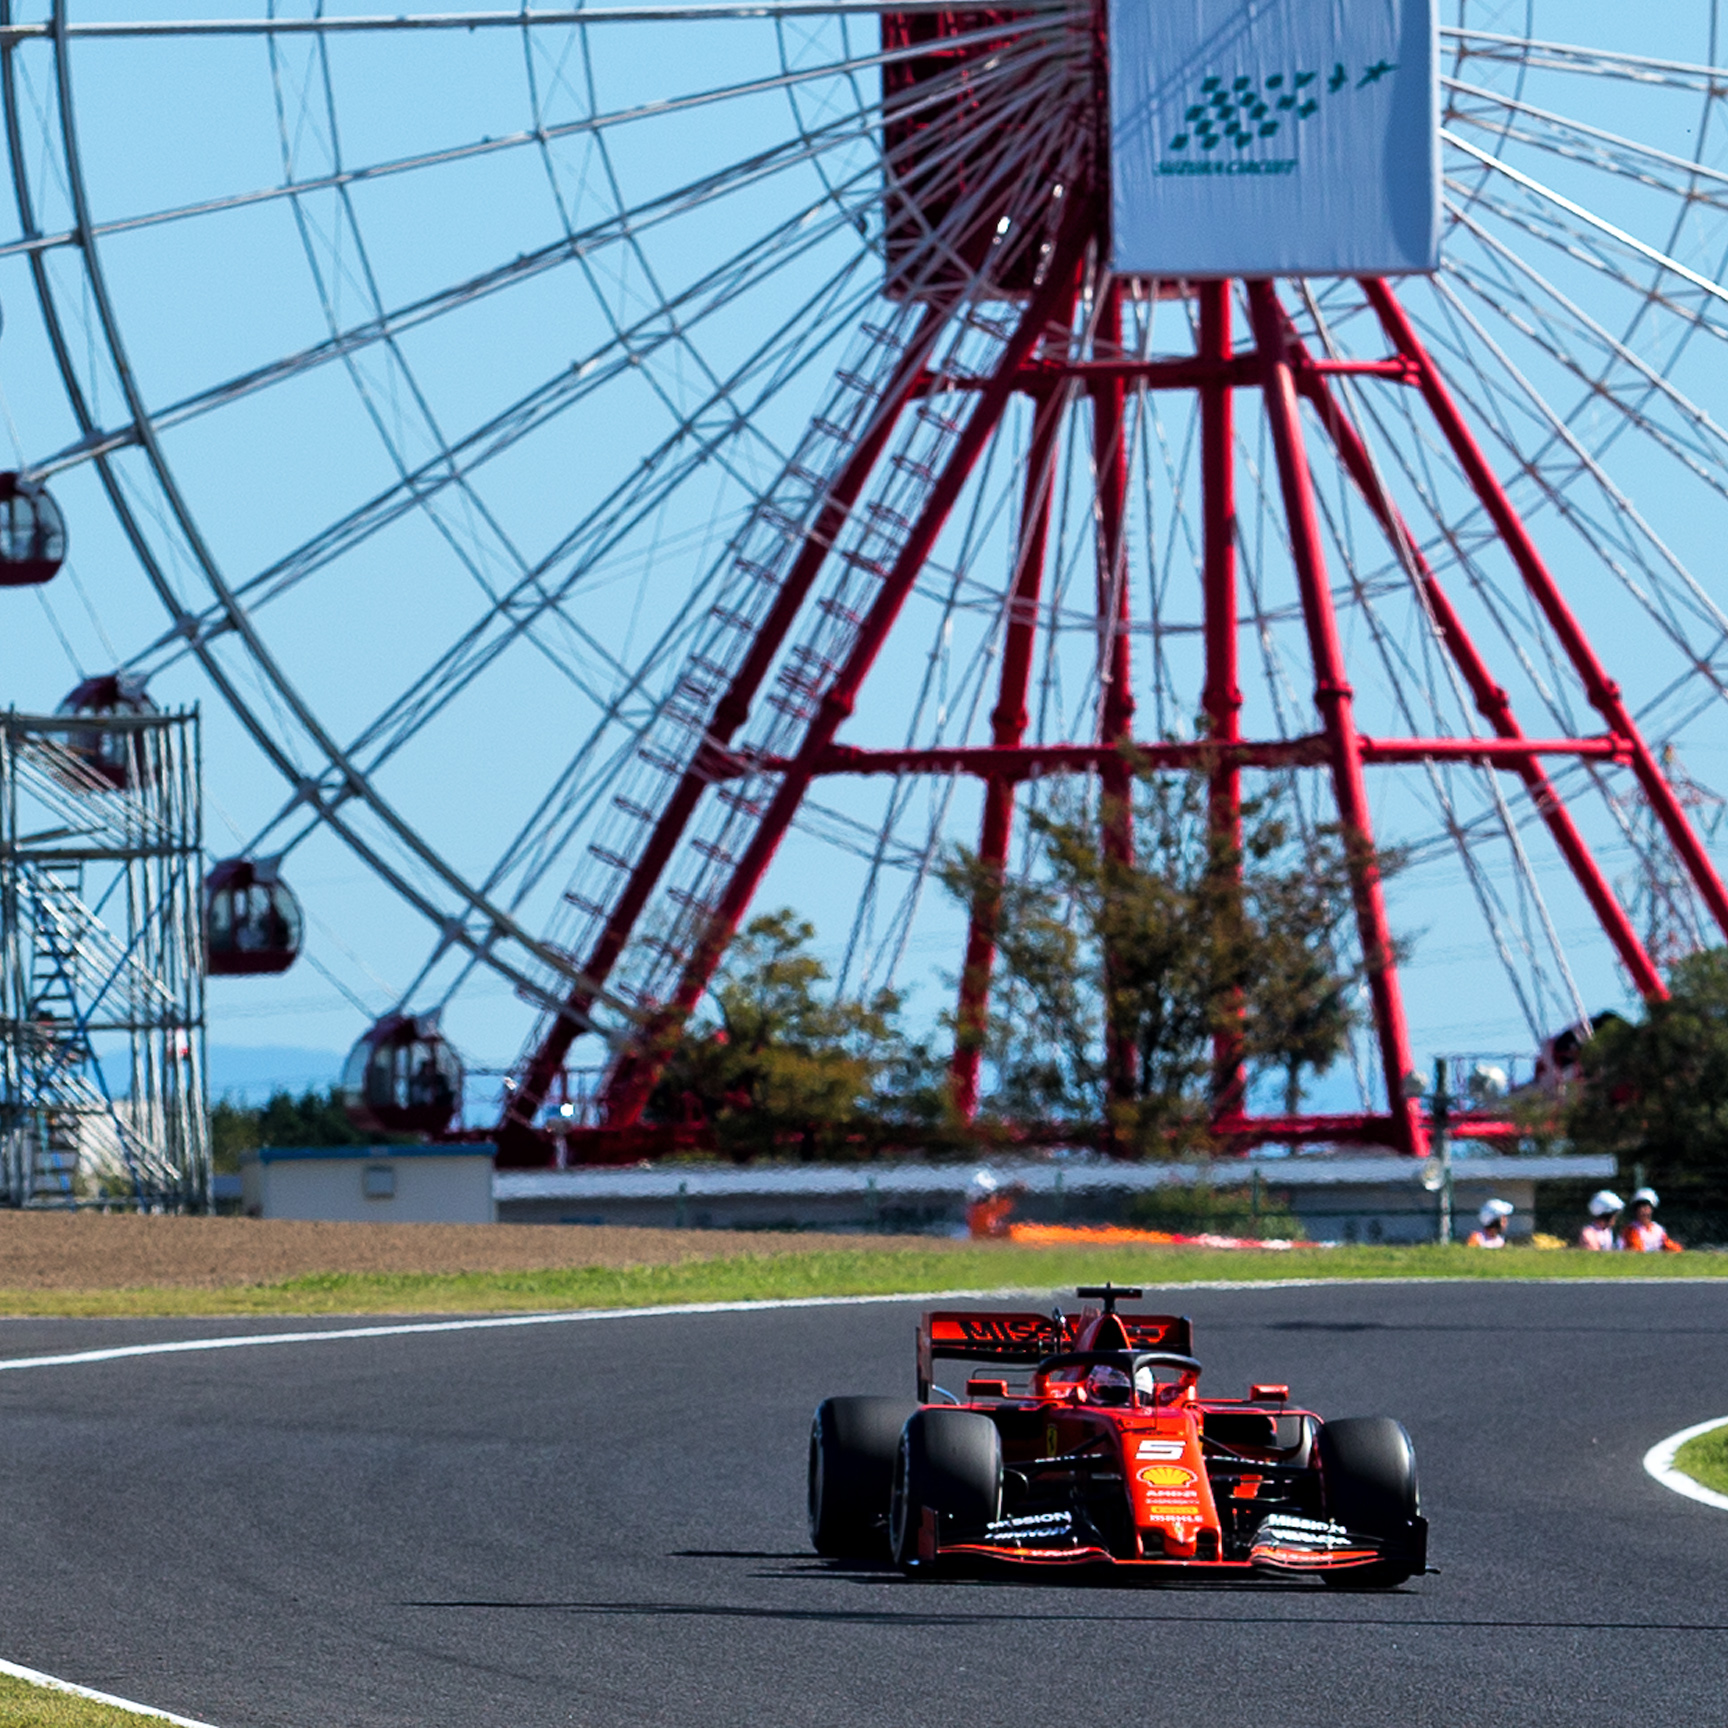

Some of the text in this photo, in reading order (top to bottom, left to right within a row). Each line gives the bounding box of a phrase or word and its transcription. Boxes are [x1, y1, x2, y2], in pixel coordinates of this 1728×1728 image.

[1135, 1440, 1186, 1460] 5
[987, 1511, 1072, 1530] MISSION
[1269, 1513, 1347, 1535] MISSION
